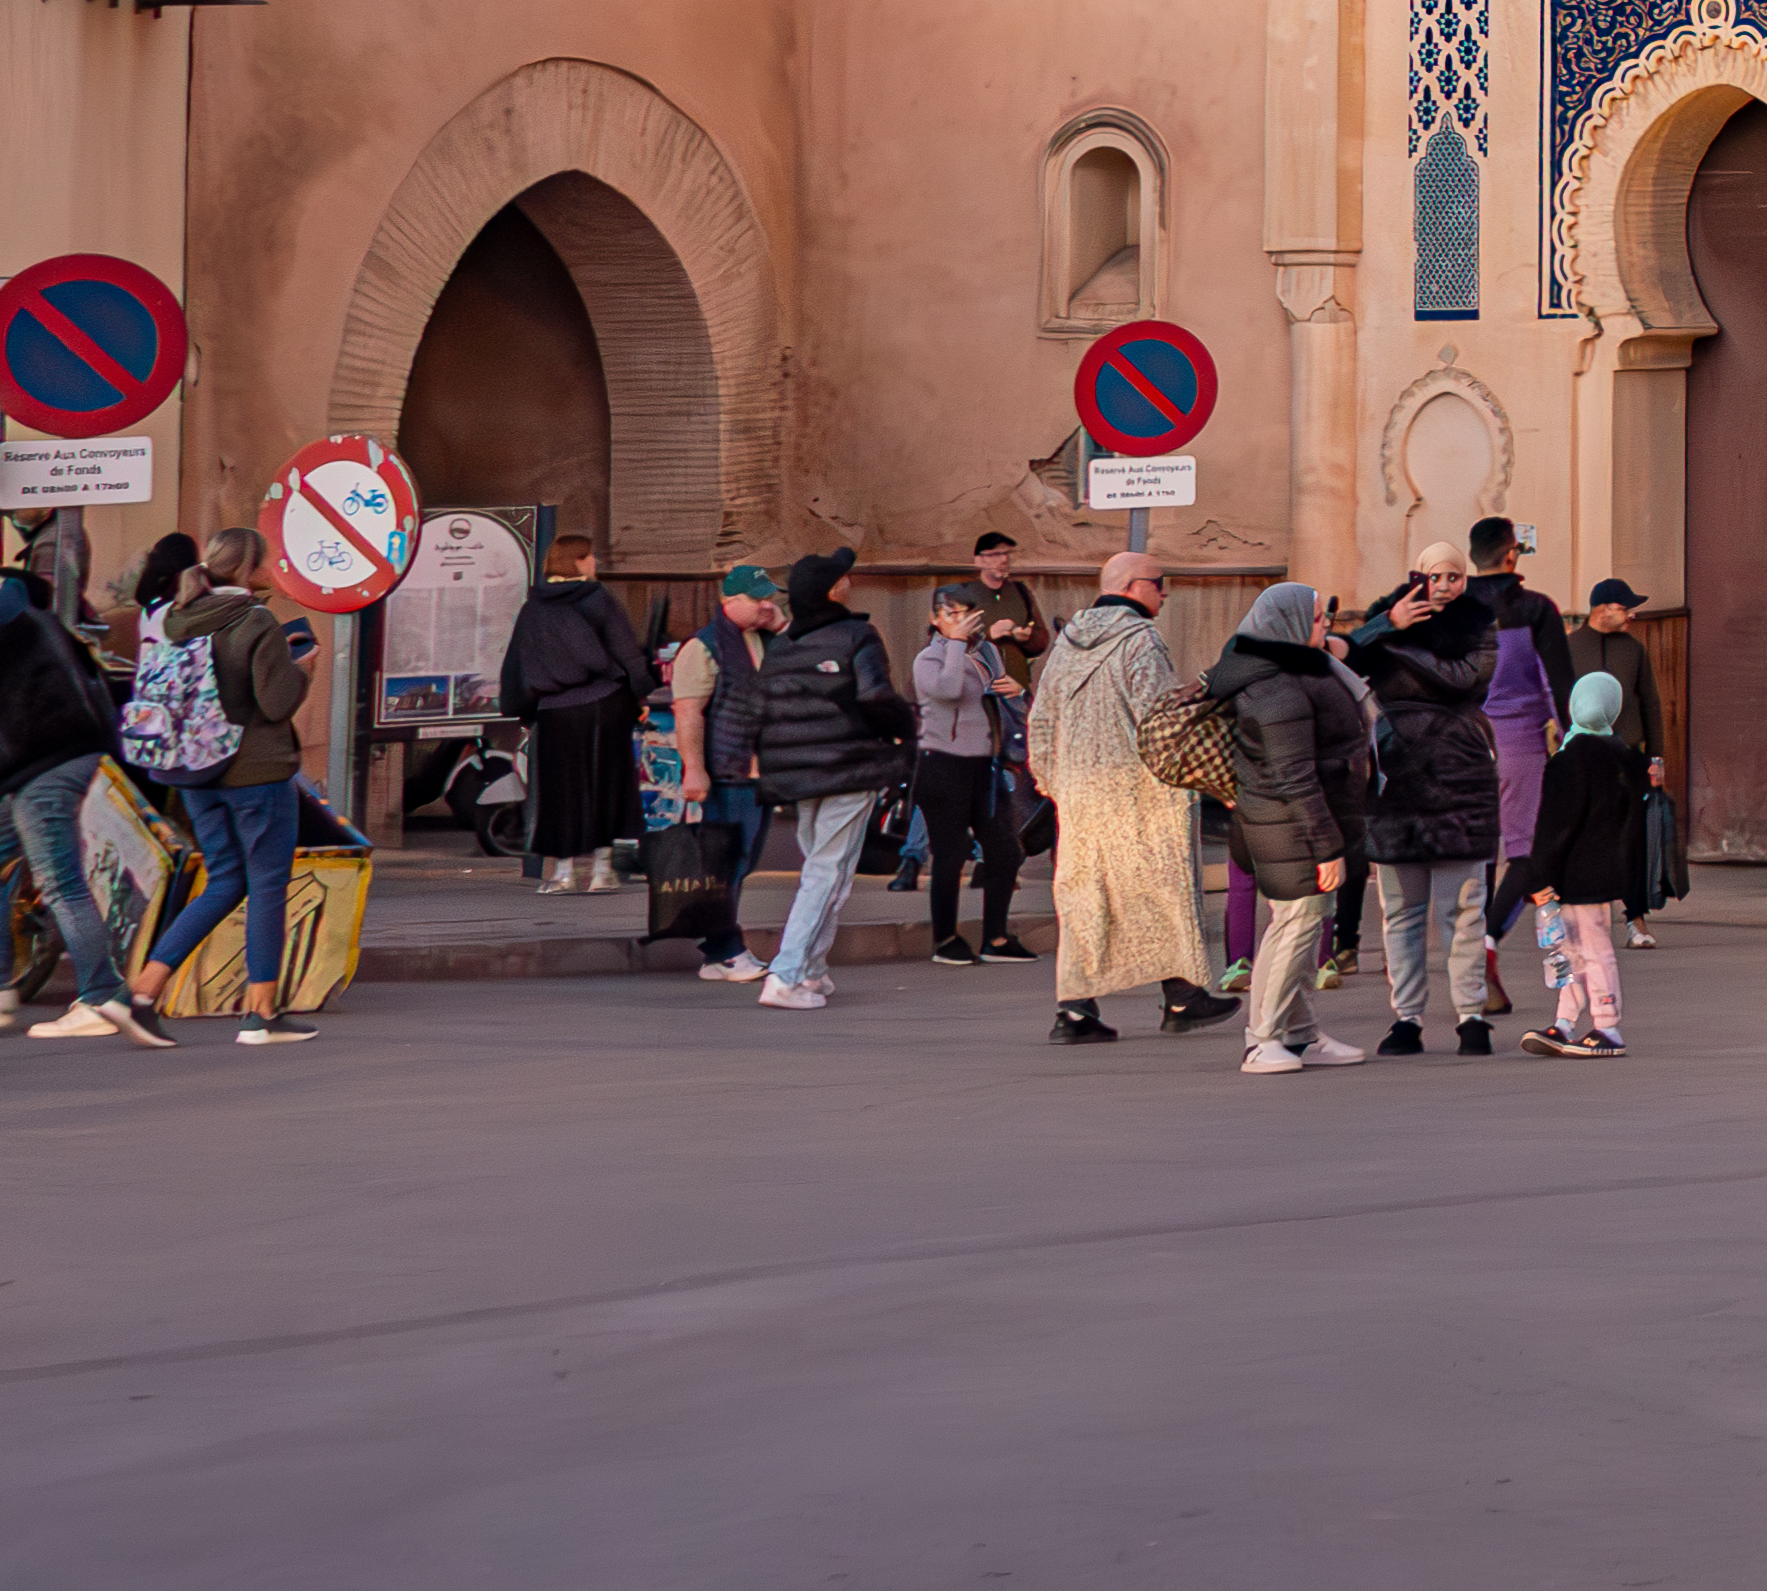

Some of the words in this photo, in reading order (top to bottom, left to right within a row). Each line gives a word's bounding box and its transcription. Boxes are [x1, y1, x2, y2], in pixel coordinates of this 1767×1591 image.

[53, 449, 76, 460] Aux
[79, 448, 146, 460] Convoyeurs
[50, 466, 64, 477] de
[66, 464, 102, 476] Fonds
[21, 486, 38, 494] DE
